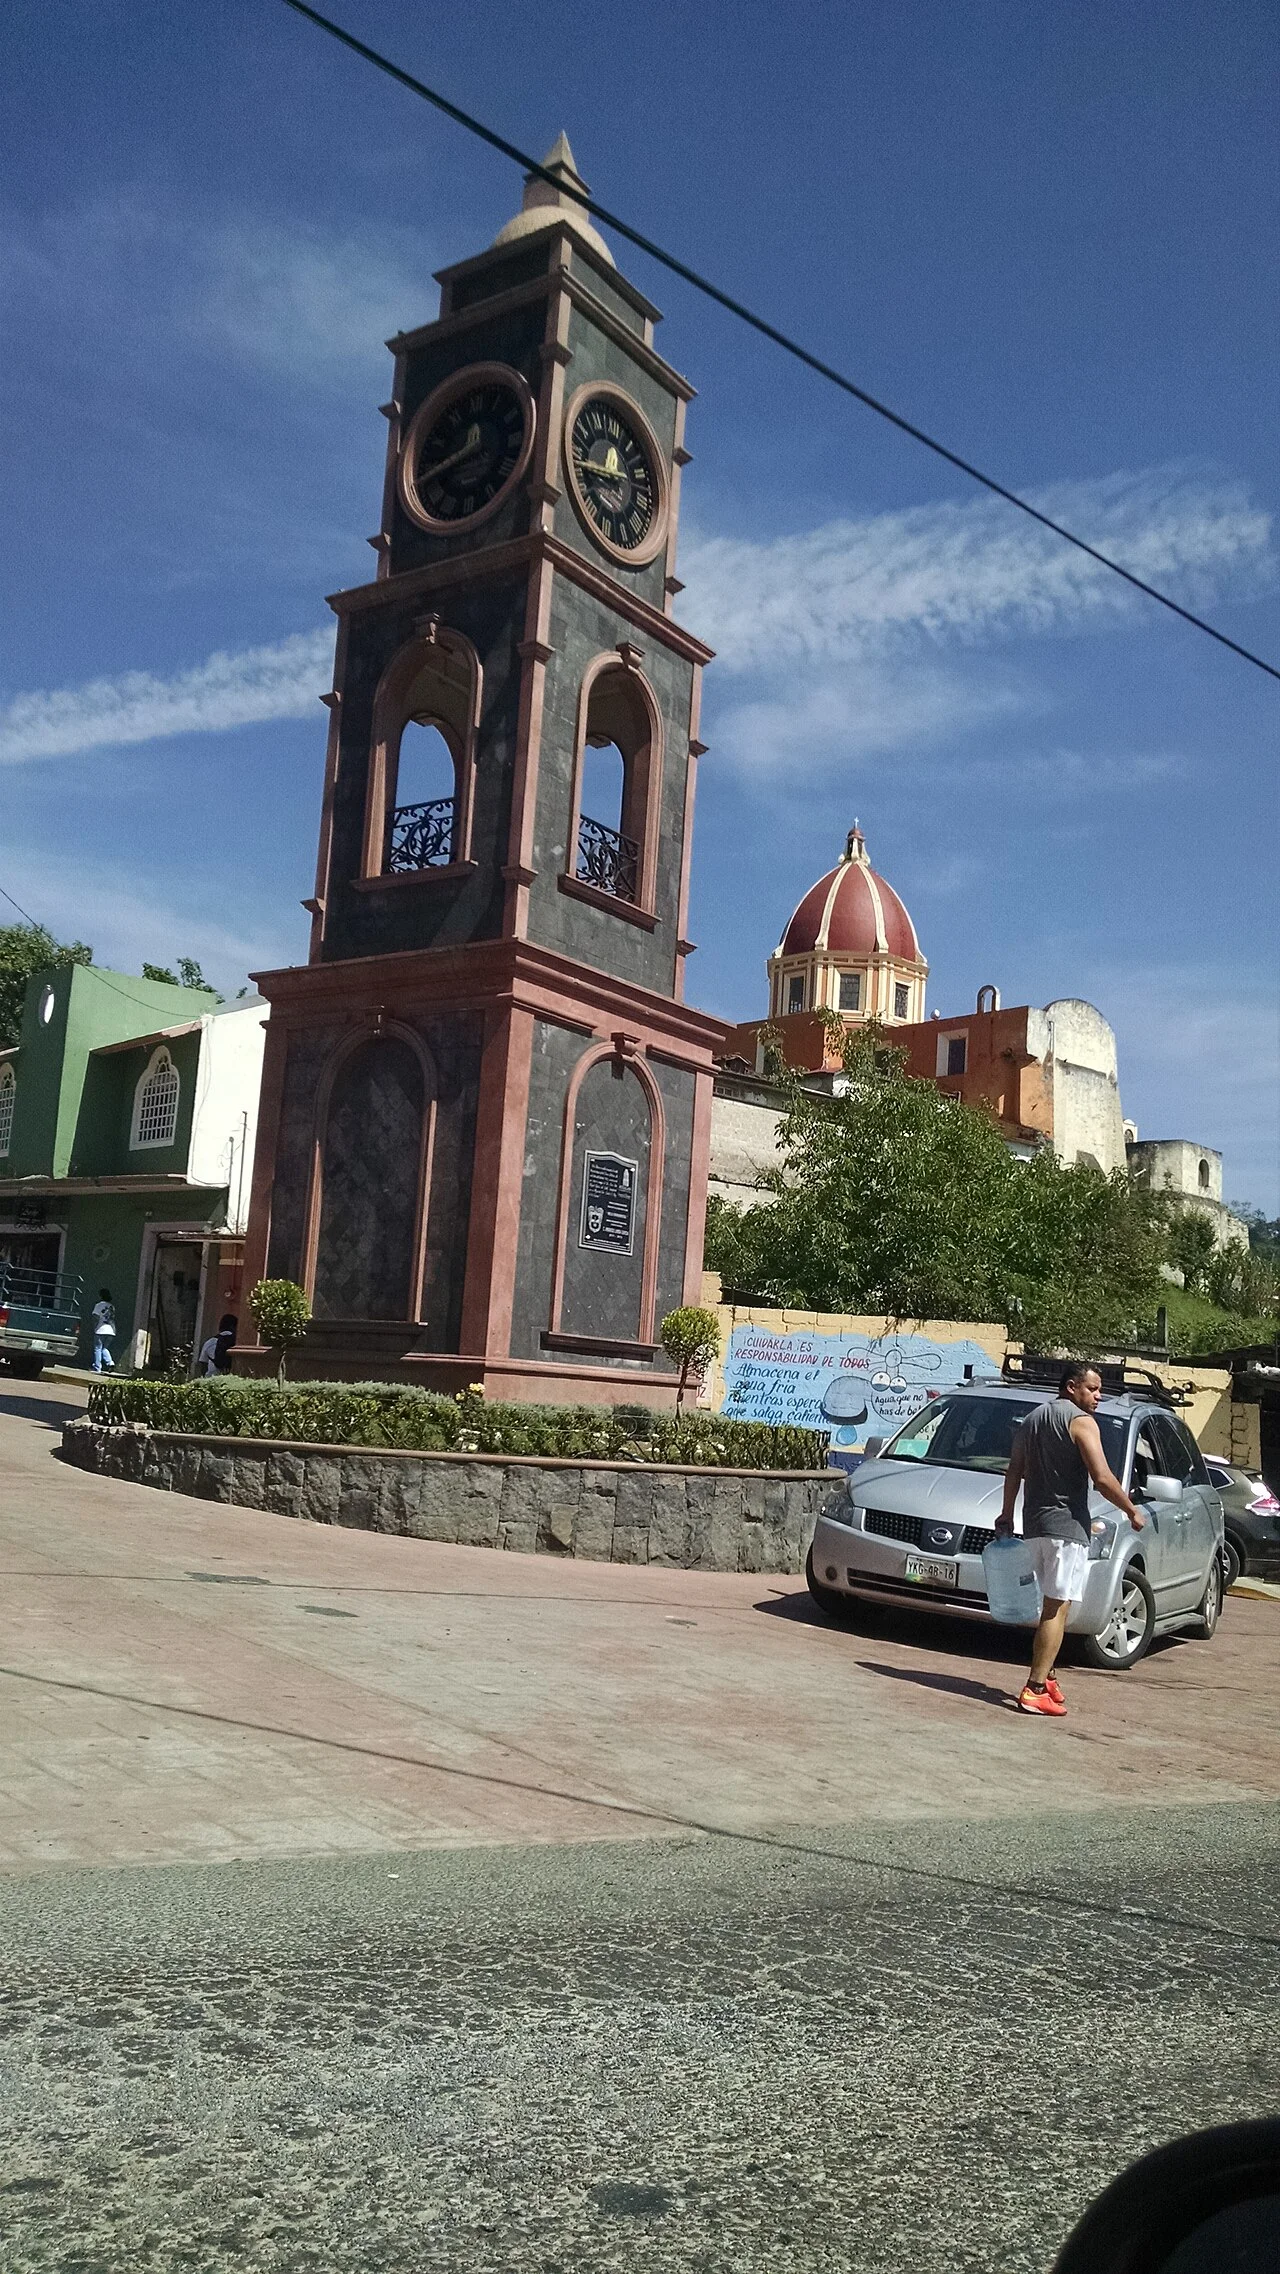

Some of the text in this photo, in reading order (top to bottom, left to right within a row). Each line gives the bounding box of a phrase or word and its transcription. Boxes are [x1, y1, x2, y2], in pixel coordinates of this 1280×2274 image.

[734, 1348, 871, 1369] RESPONSABILIDAD DE TODOS
[732, 1363, 821, 1381] Almacena el
[875, 1394, 924, 1406] Agua que no
[750, 1406, 783, 1423] salga
[879, 1406, 894, 1415] has
[894, 1405, 906, 1416] de
